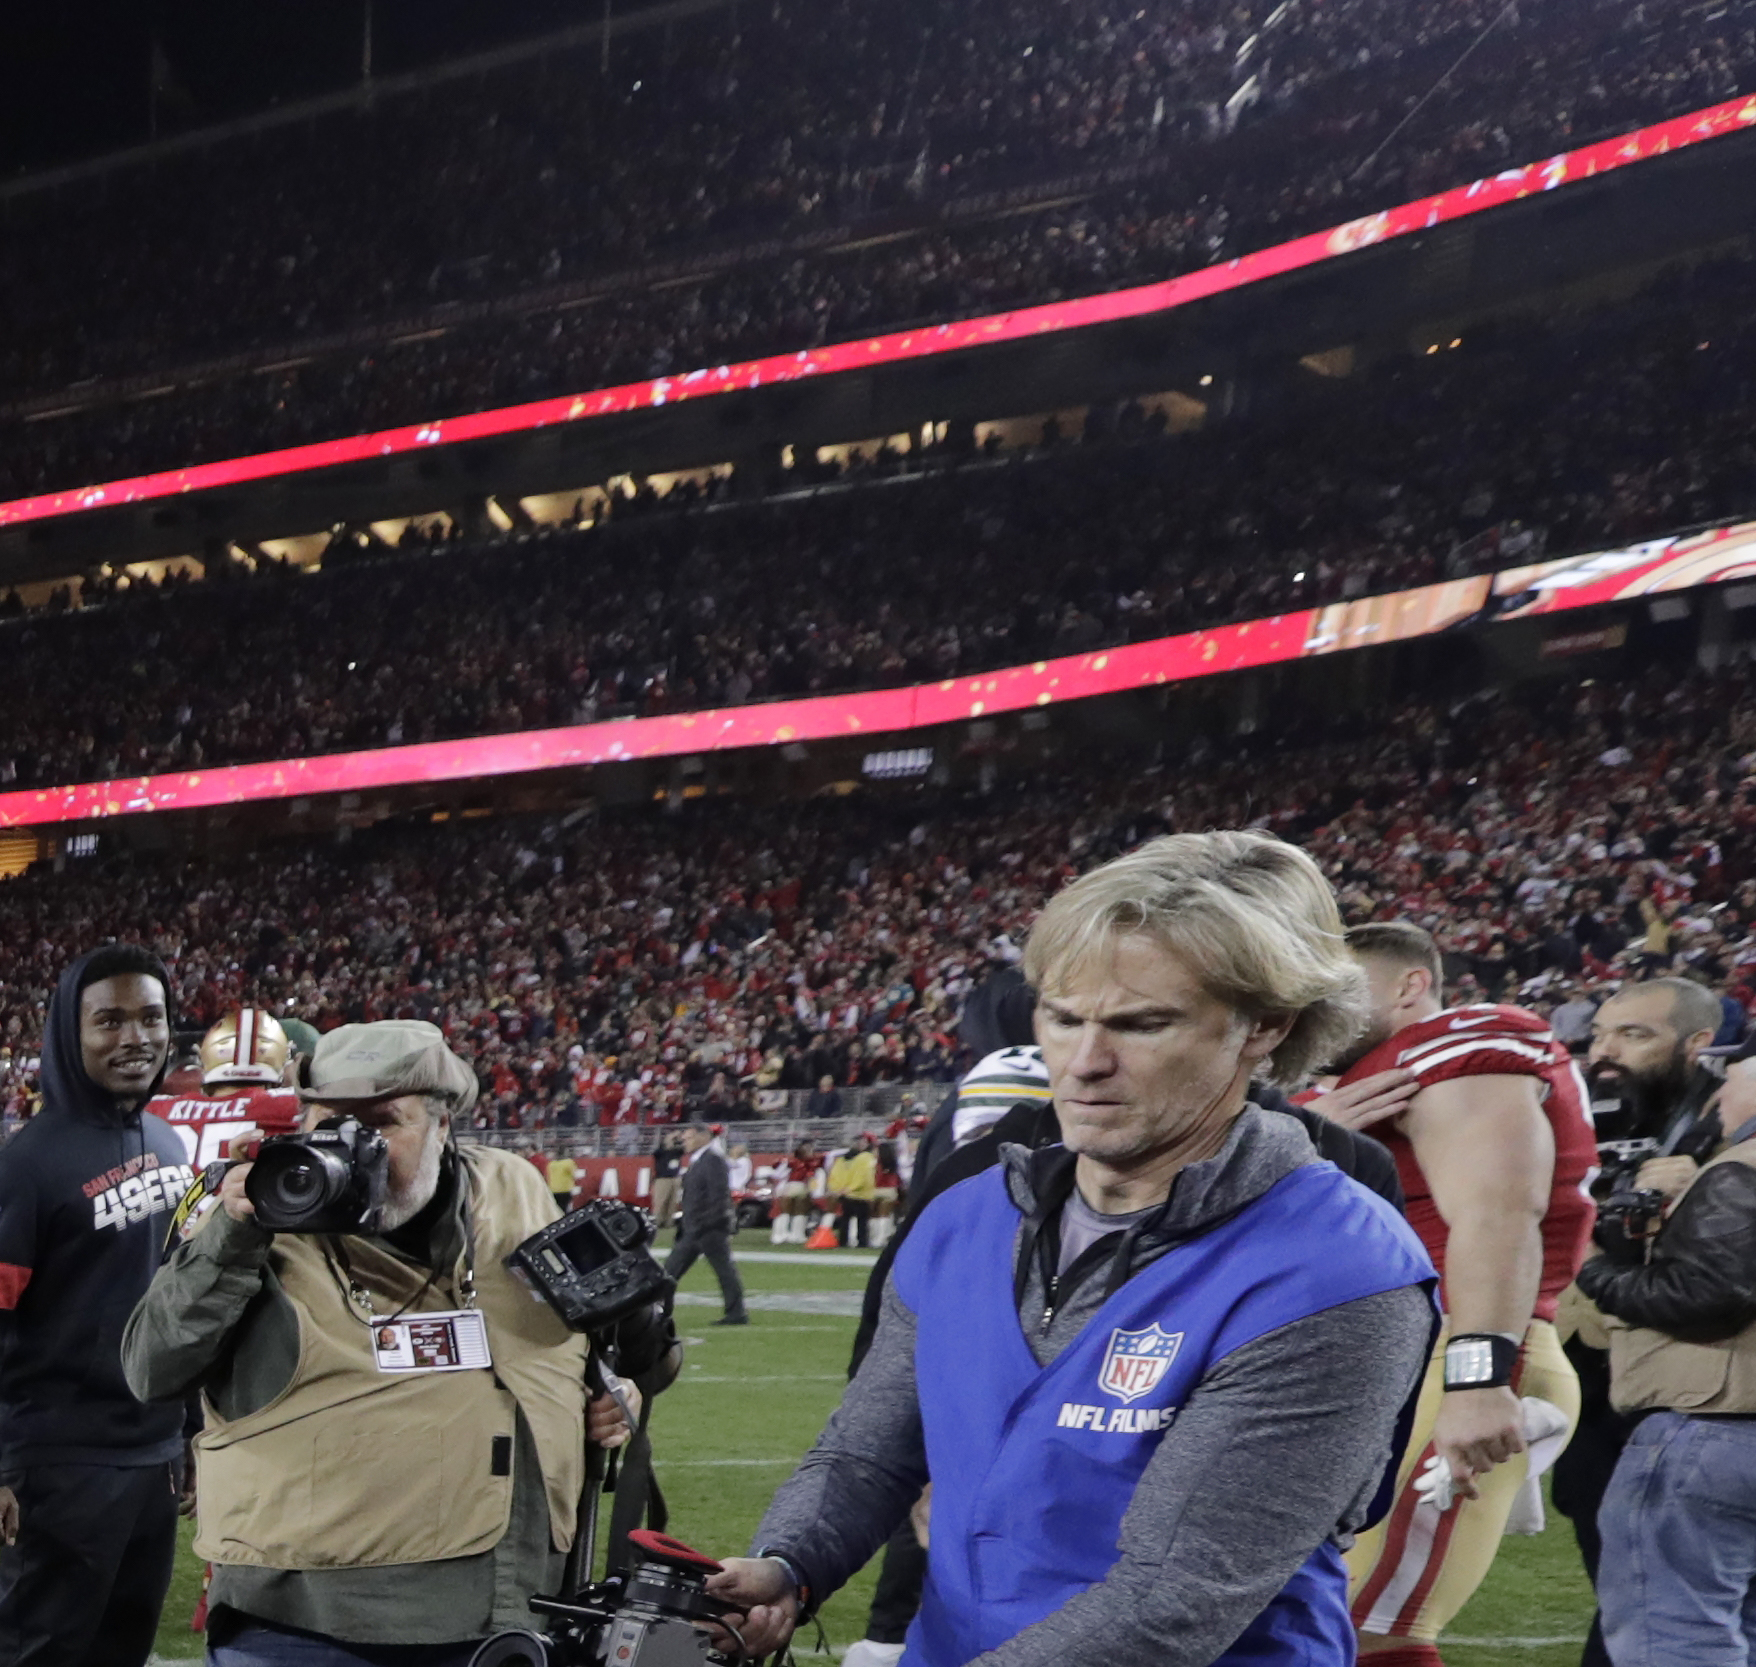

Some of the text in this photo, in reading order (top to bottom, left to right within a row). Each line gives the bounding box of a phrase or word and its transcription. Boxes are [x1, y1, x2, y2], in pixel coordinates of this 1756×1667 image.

[168, 1098, 252, 1121] KITTLE
[311, 1130, 338, 1142] Nikon
[82, 1174, 109, 1198] SAN
[1109, 1356, 1160, 1391] NFL
[1056, 1402, 1176, 1434] NFL FILMS
